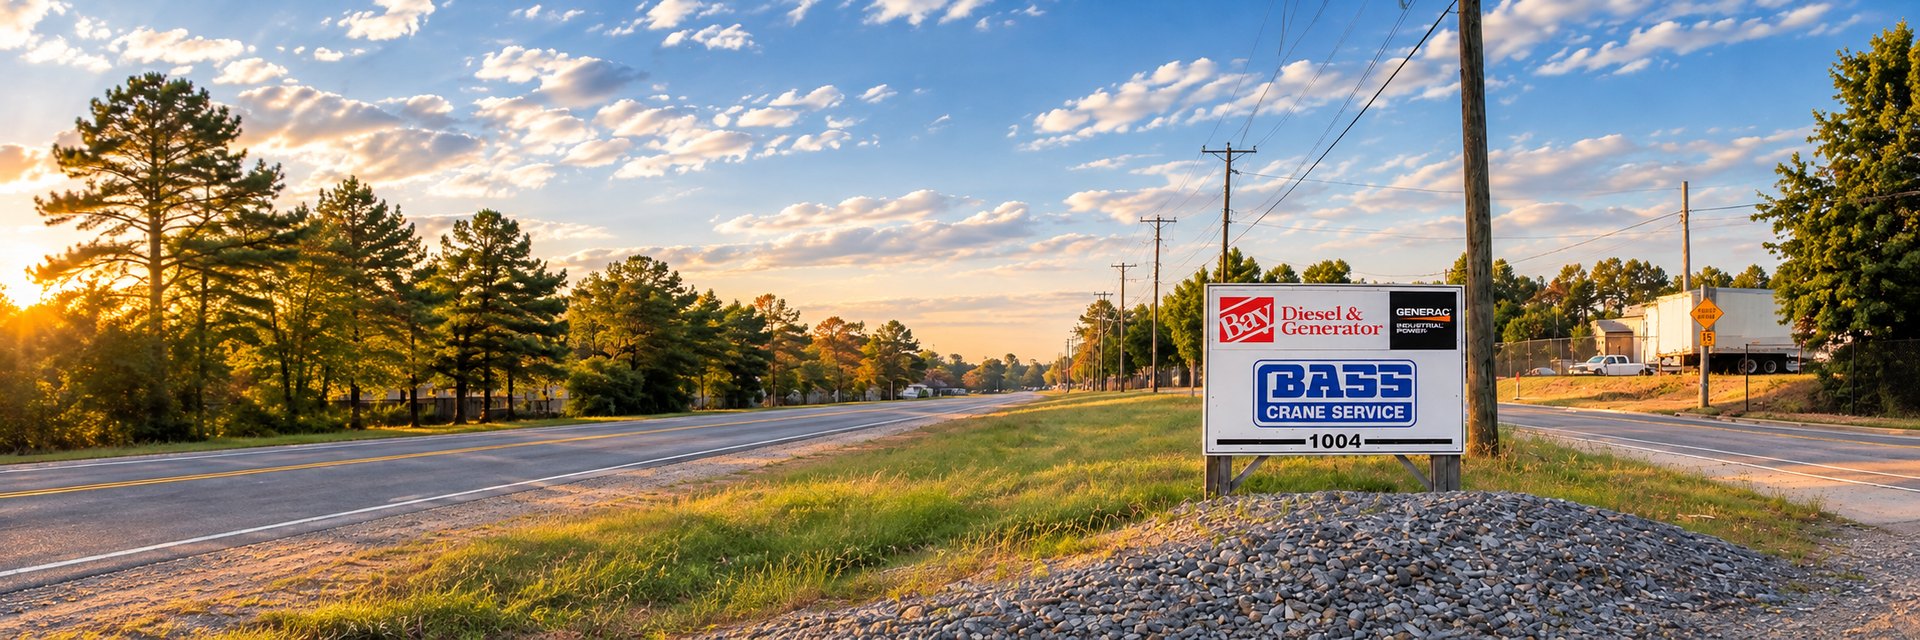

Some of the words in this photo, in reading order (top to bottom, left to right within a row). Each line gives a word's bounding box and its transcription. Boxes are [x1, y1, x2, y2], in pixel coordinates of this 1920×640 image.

[1281, 306, 1341, 321] Diesel
[1346, 306, 1363, 321] &
[1396, 307, 1451, 317] GENERAC
[1219, 302, 1272, 341] Bay
[1281, 322, 1384, 336] Generator
[1271, 364, 1412, 398] BASS
[1266, 405, 1326, 420] CRANE
[1331, 405, 1405, 420] SERVICE
[1308, 433, 1362, 449] 1004
